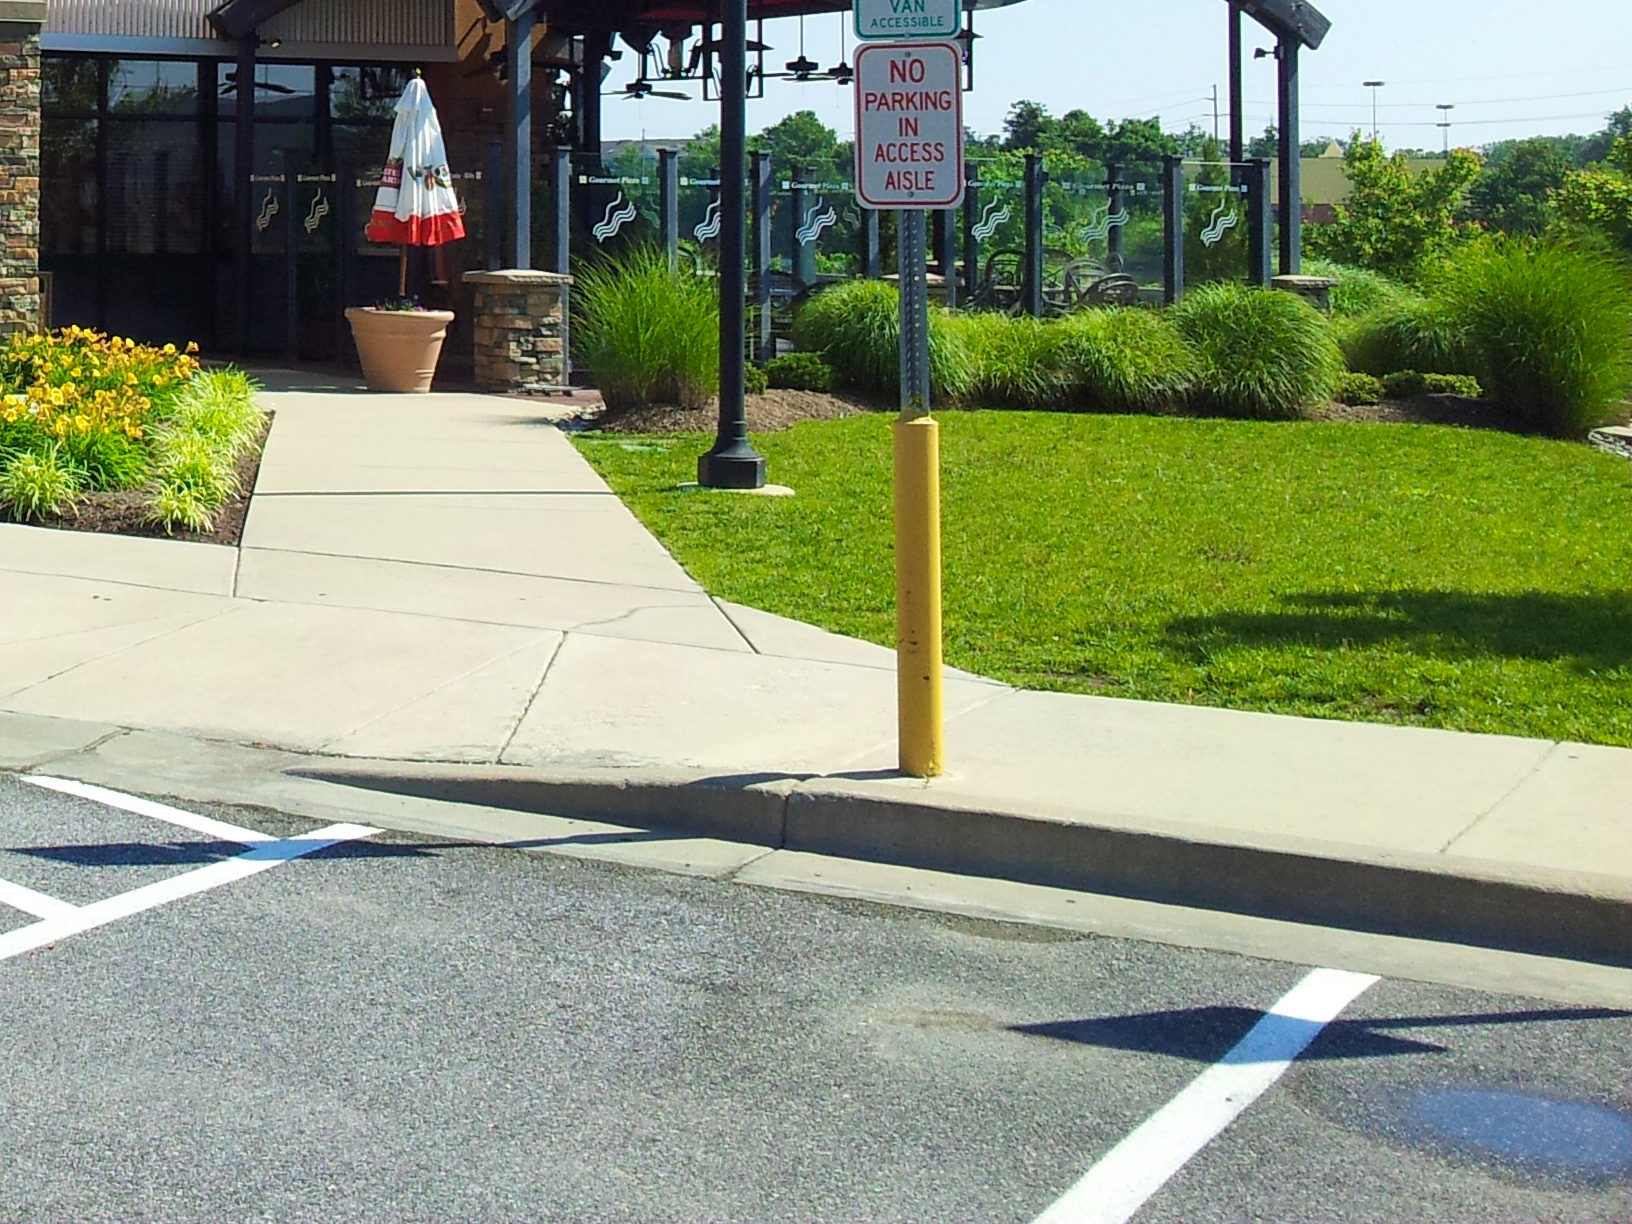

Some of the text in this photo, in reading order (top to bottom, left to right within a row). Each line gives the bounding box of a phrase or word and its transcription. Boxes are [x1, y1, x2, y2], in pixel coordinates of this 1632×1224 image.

[870, 16, 944, 28] ACCESSIBLE
[889, 58, 926, 83] NO
[864, 91, 952, 112] PARKING
[898, 117, 919, 137] IN
[874, 143, 945, 163] ACCESS
[884, 170, 935, 191] AISLE
